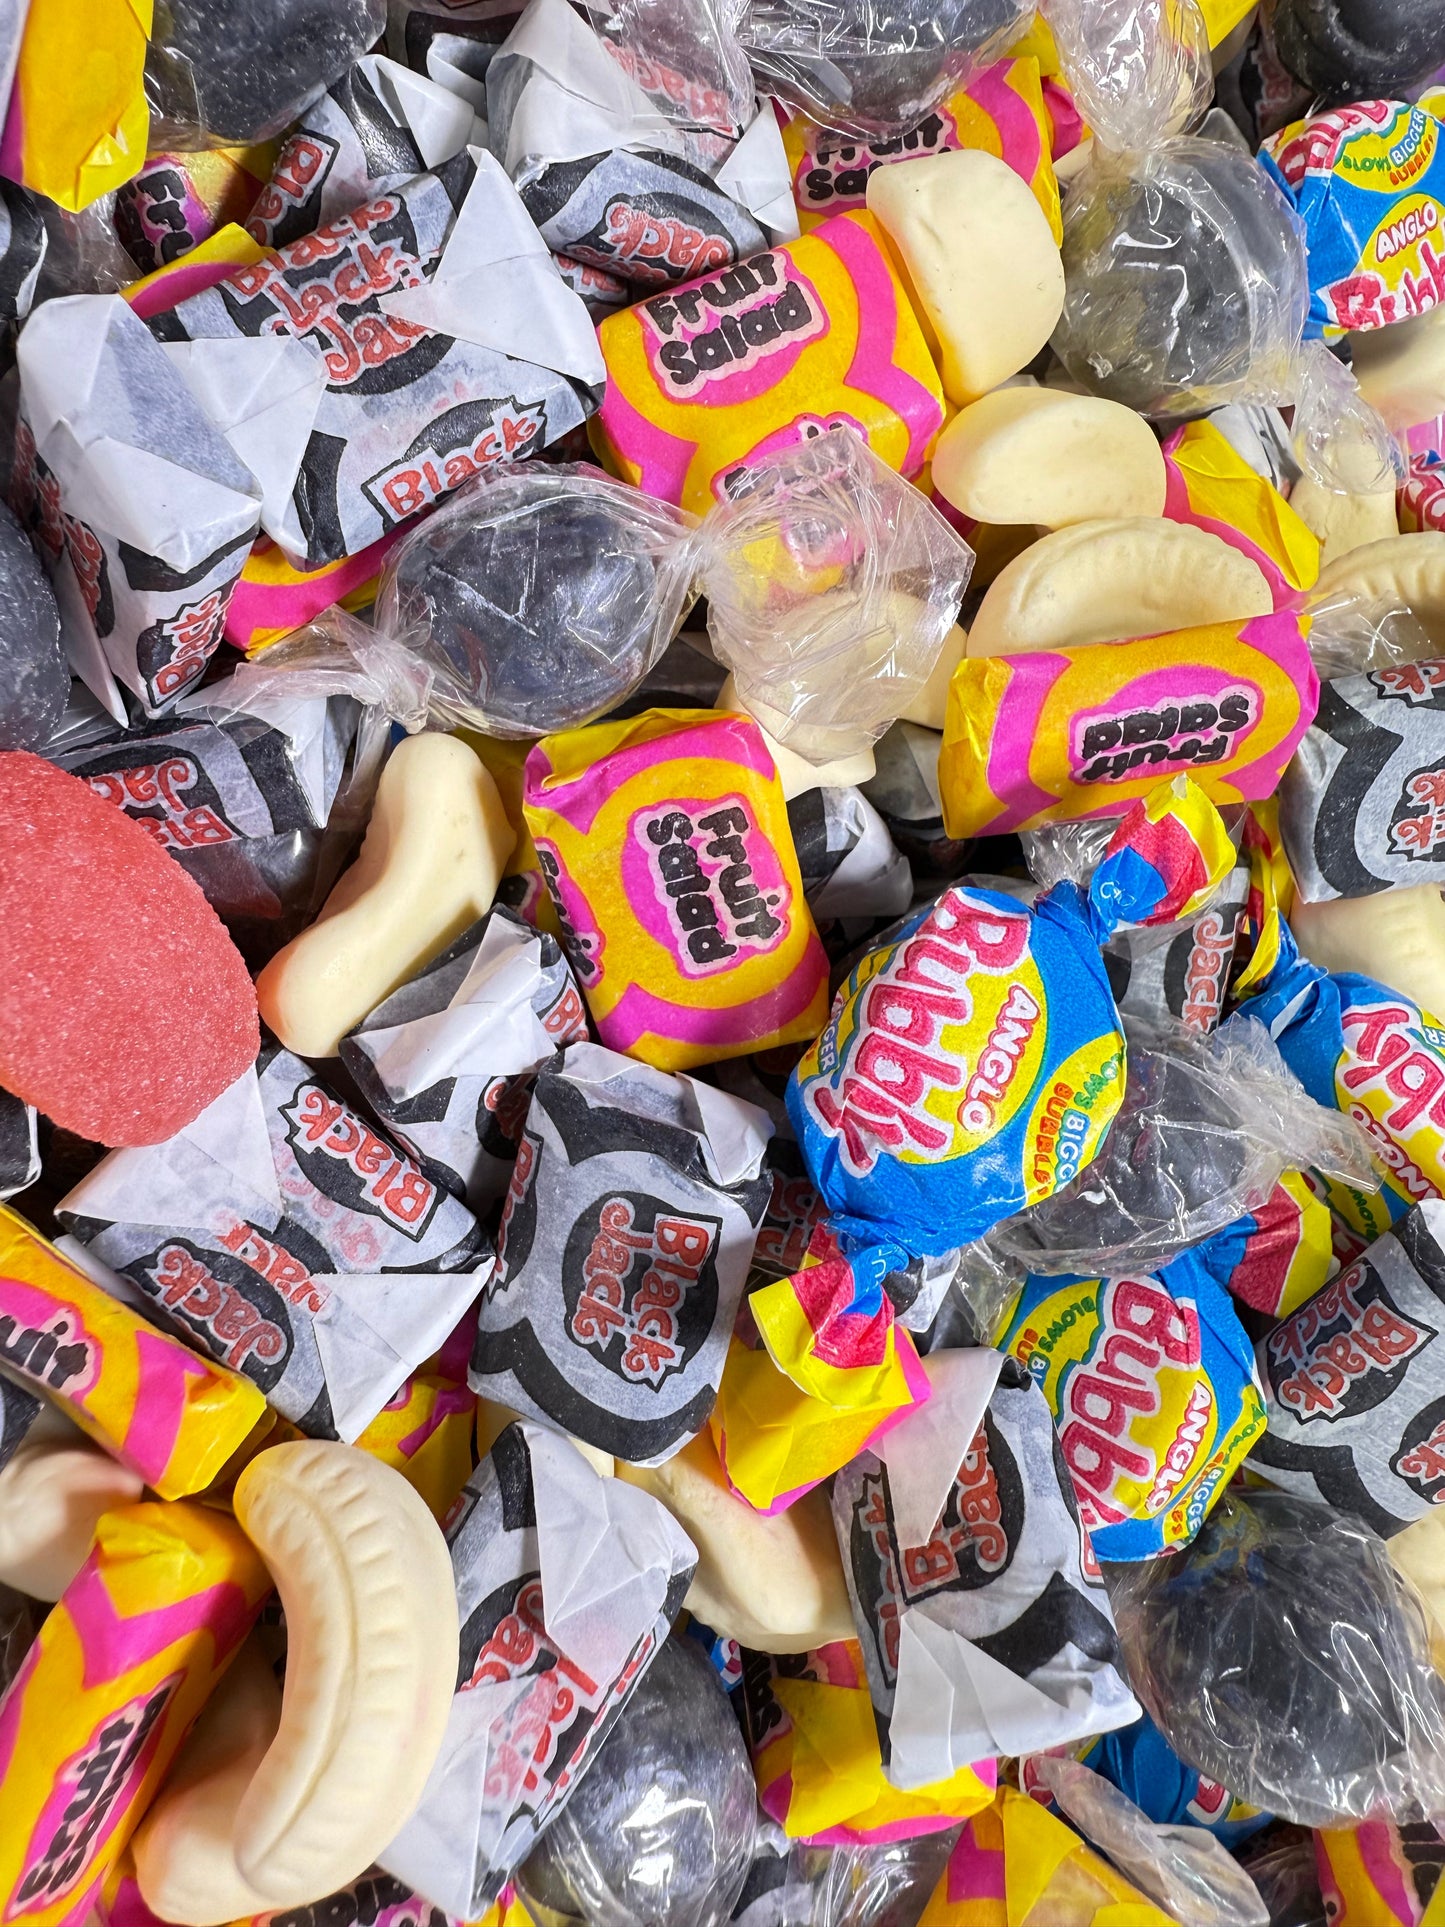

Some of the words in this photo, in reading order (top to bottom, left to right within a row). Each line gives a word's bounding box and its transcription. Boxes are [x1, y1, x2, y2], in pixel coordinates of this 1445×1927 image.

[1391, 110, 1425, 166] BIGGER
[610, 205, 729, 284] Jack
[1376, 202, 1437, 262] ANGLO
[645, 253, 777, 335] Fruit
[660, 281, 812, 385] Salad
[383, 417, 537, 516] Black
[156, 596, 219, 695] Black
[1082, 694, 1249, 760] Salad
[1083, 735, 1228, 780] Fruit
[83, 759, 190, 812] Jac
[646, 811, 737, 963] Salad
[697, 806, 781, 939] Fruit
[814, 889, 1032, 1170] Bubbly
[958, 985, 1040, 1134] ANGLO
[299, 1090, 432, 1223] Black
[158, 1249, 283, 1366] Jack
[573, 1203, 653, 1338] Jack
[625, 1219, 710, 1373] Black
[1274, 1267, 1361, 1358] Jack
[1039, 1295, 1096, 1353] BLOWS
[1283, 1305, 1418, 1411] Black
[1188, 1468, 1222, 1531] BIGGE
